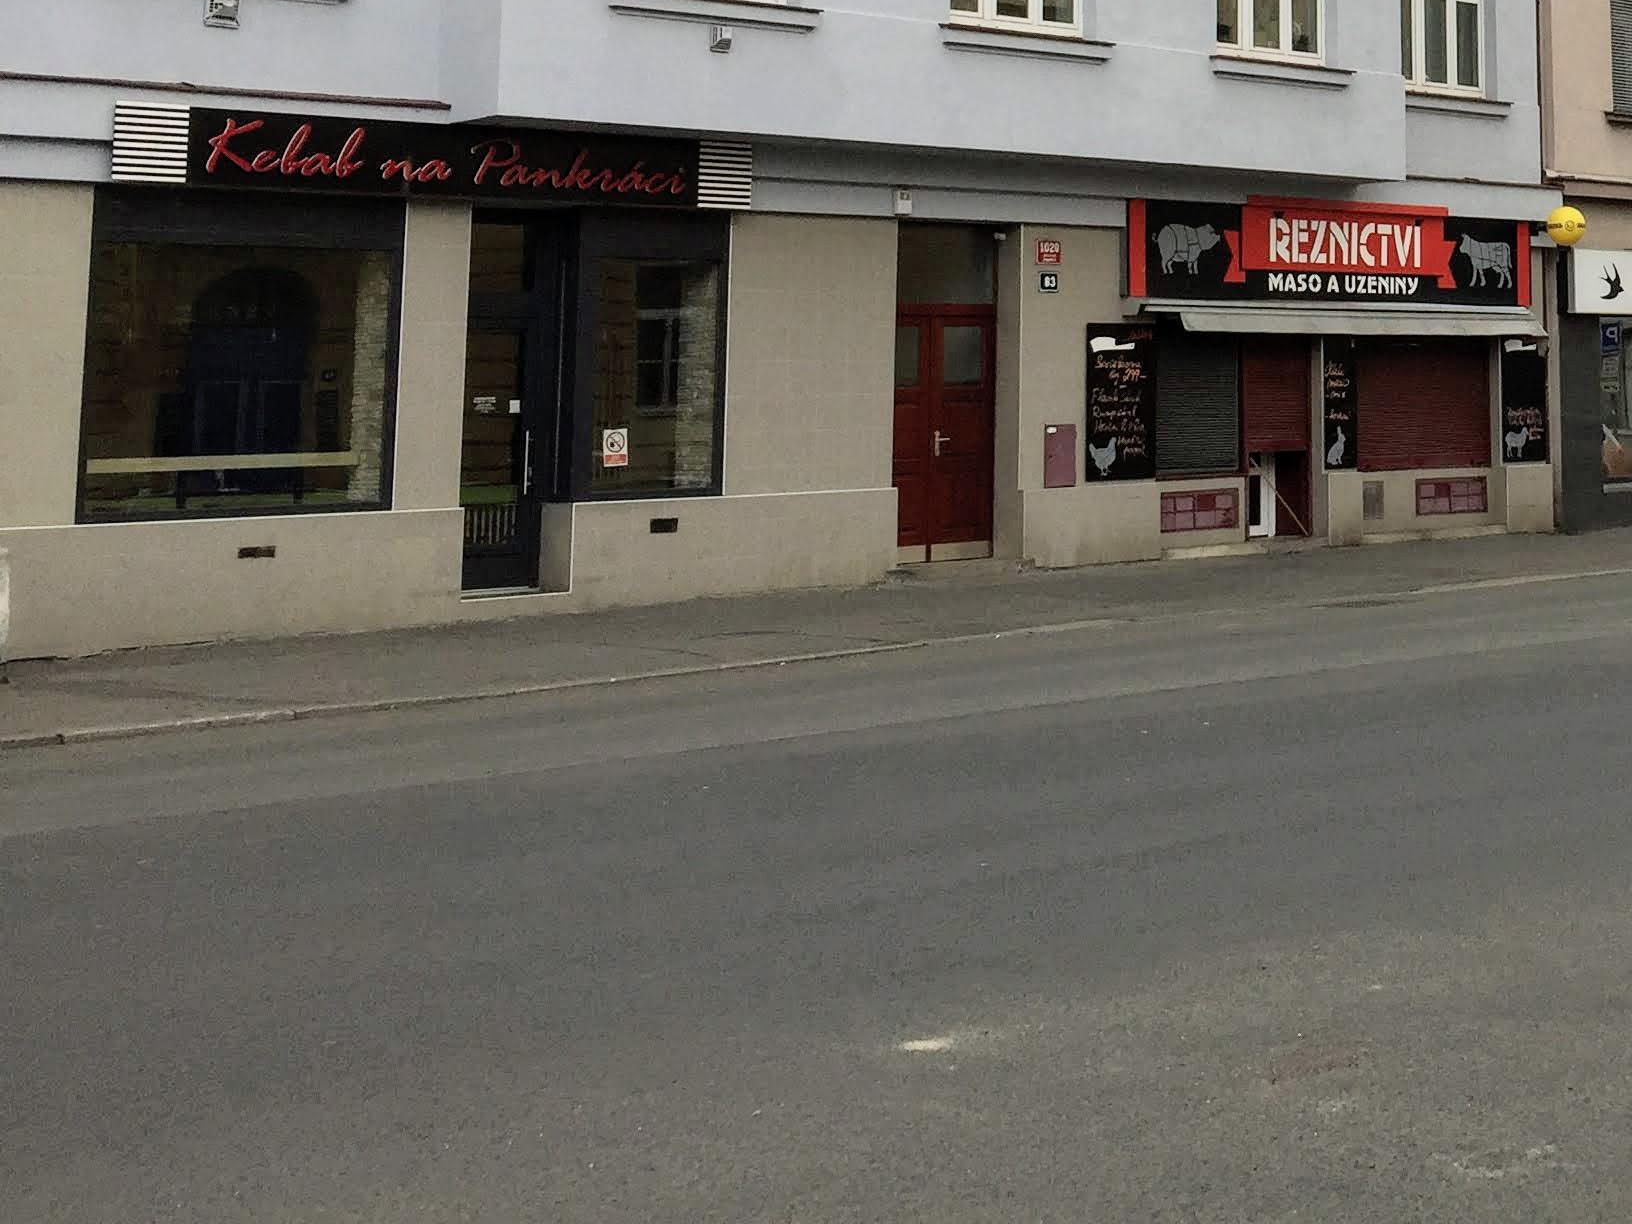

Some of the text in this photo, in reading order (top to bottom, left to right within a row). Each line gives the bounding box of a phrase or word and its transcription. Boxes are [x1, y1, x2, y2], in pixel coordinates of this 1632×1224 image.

[206, 119, 688, 194] Kebab na Pankráci
[1268, 273, 1419, 296] MASO A UZENINY
